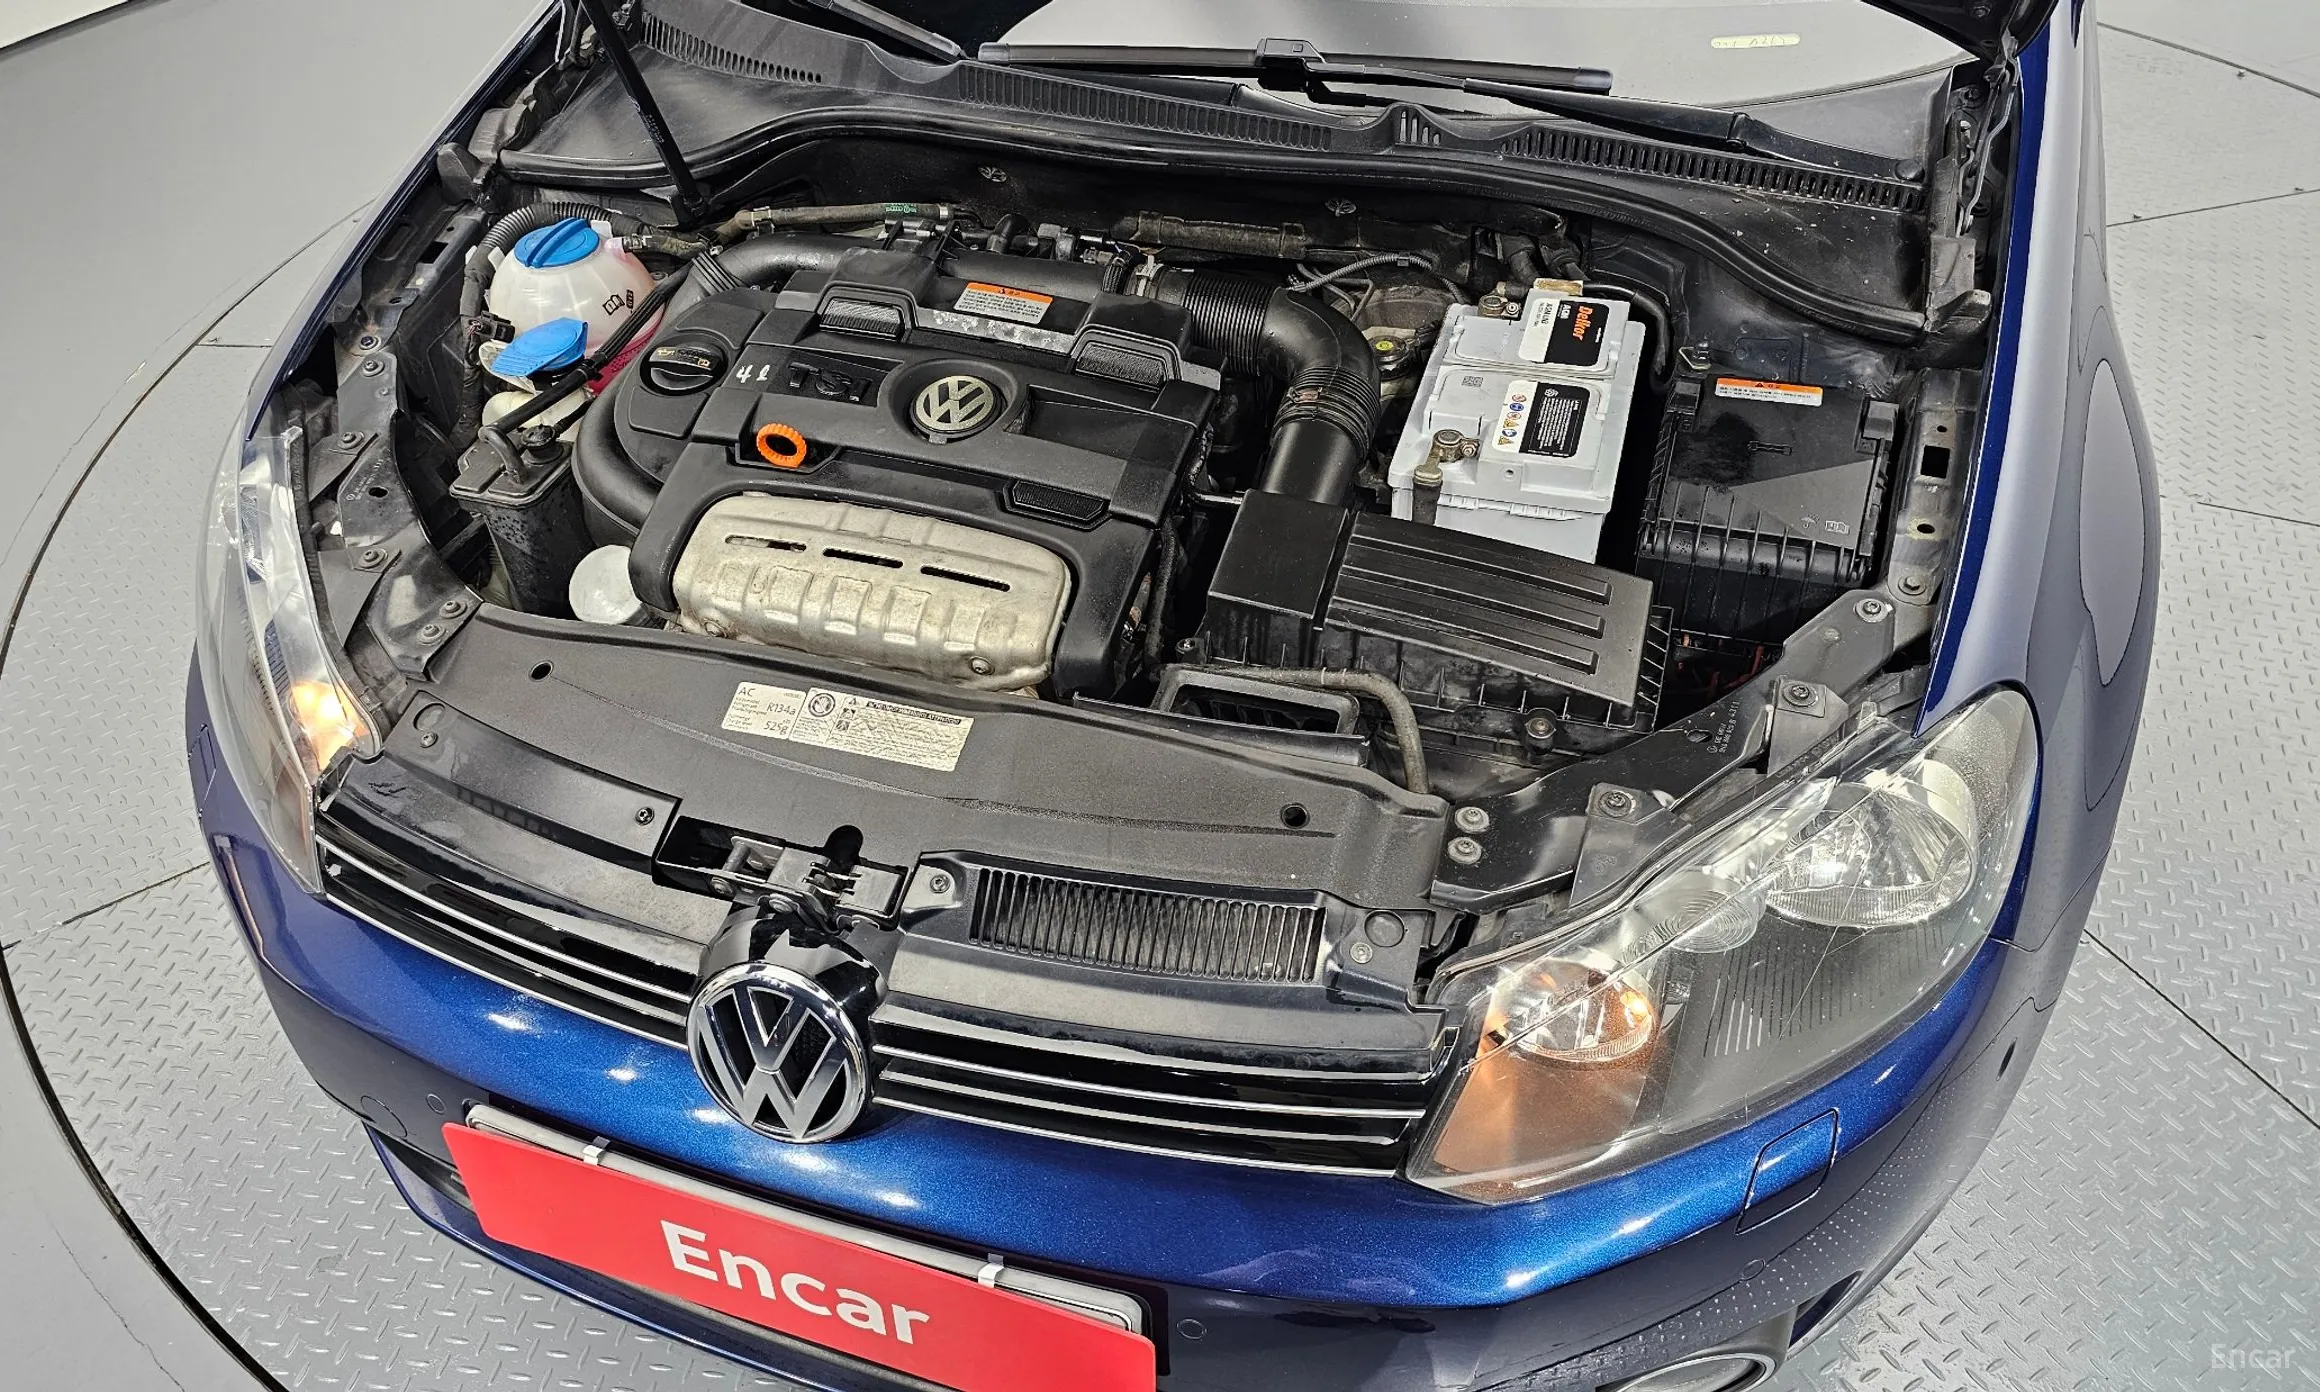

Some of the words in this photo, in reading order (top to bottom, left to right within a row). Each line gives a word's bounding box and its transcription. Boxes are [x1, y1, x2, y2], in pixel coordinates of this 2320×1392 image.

[1572, 305, 1593, 341] Delkor
[787, 360, 873, 402] TSI
[738, 686, 756, 697] AC
[766, 701, 797, 716] R134a
[763, 720, 789, 736] 525g
[687, 961, 869, 1144] VW
[659, 1219, 931, 1345] Encar
